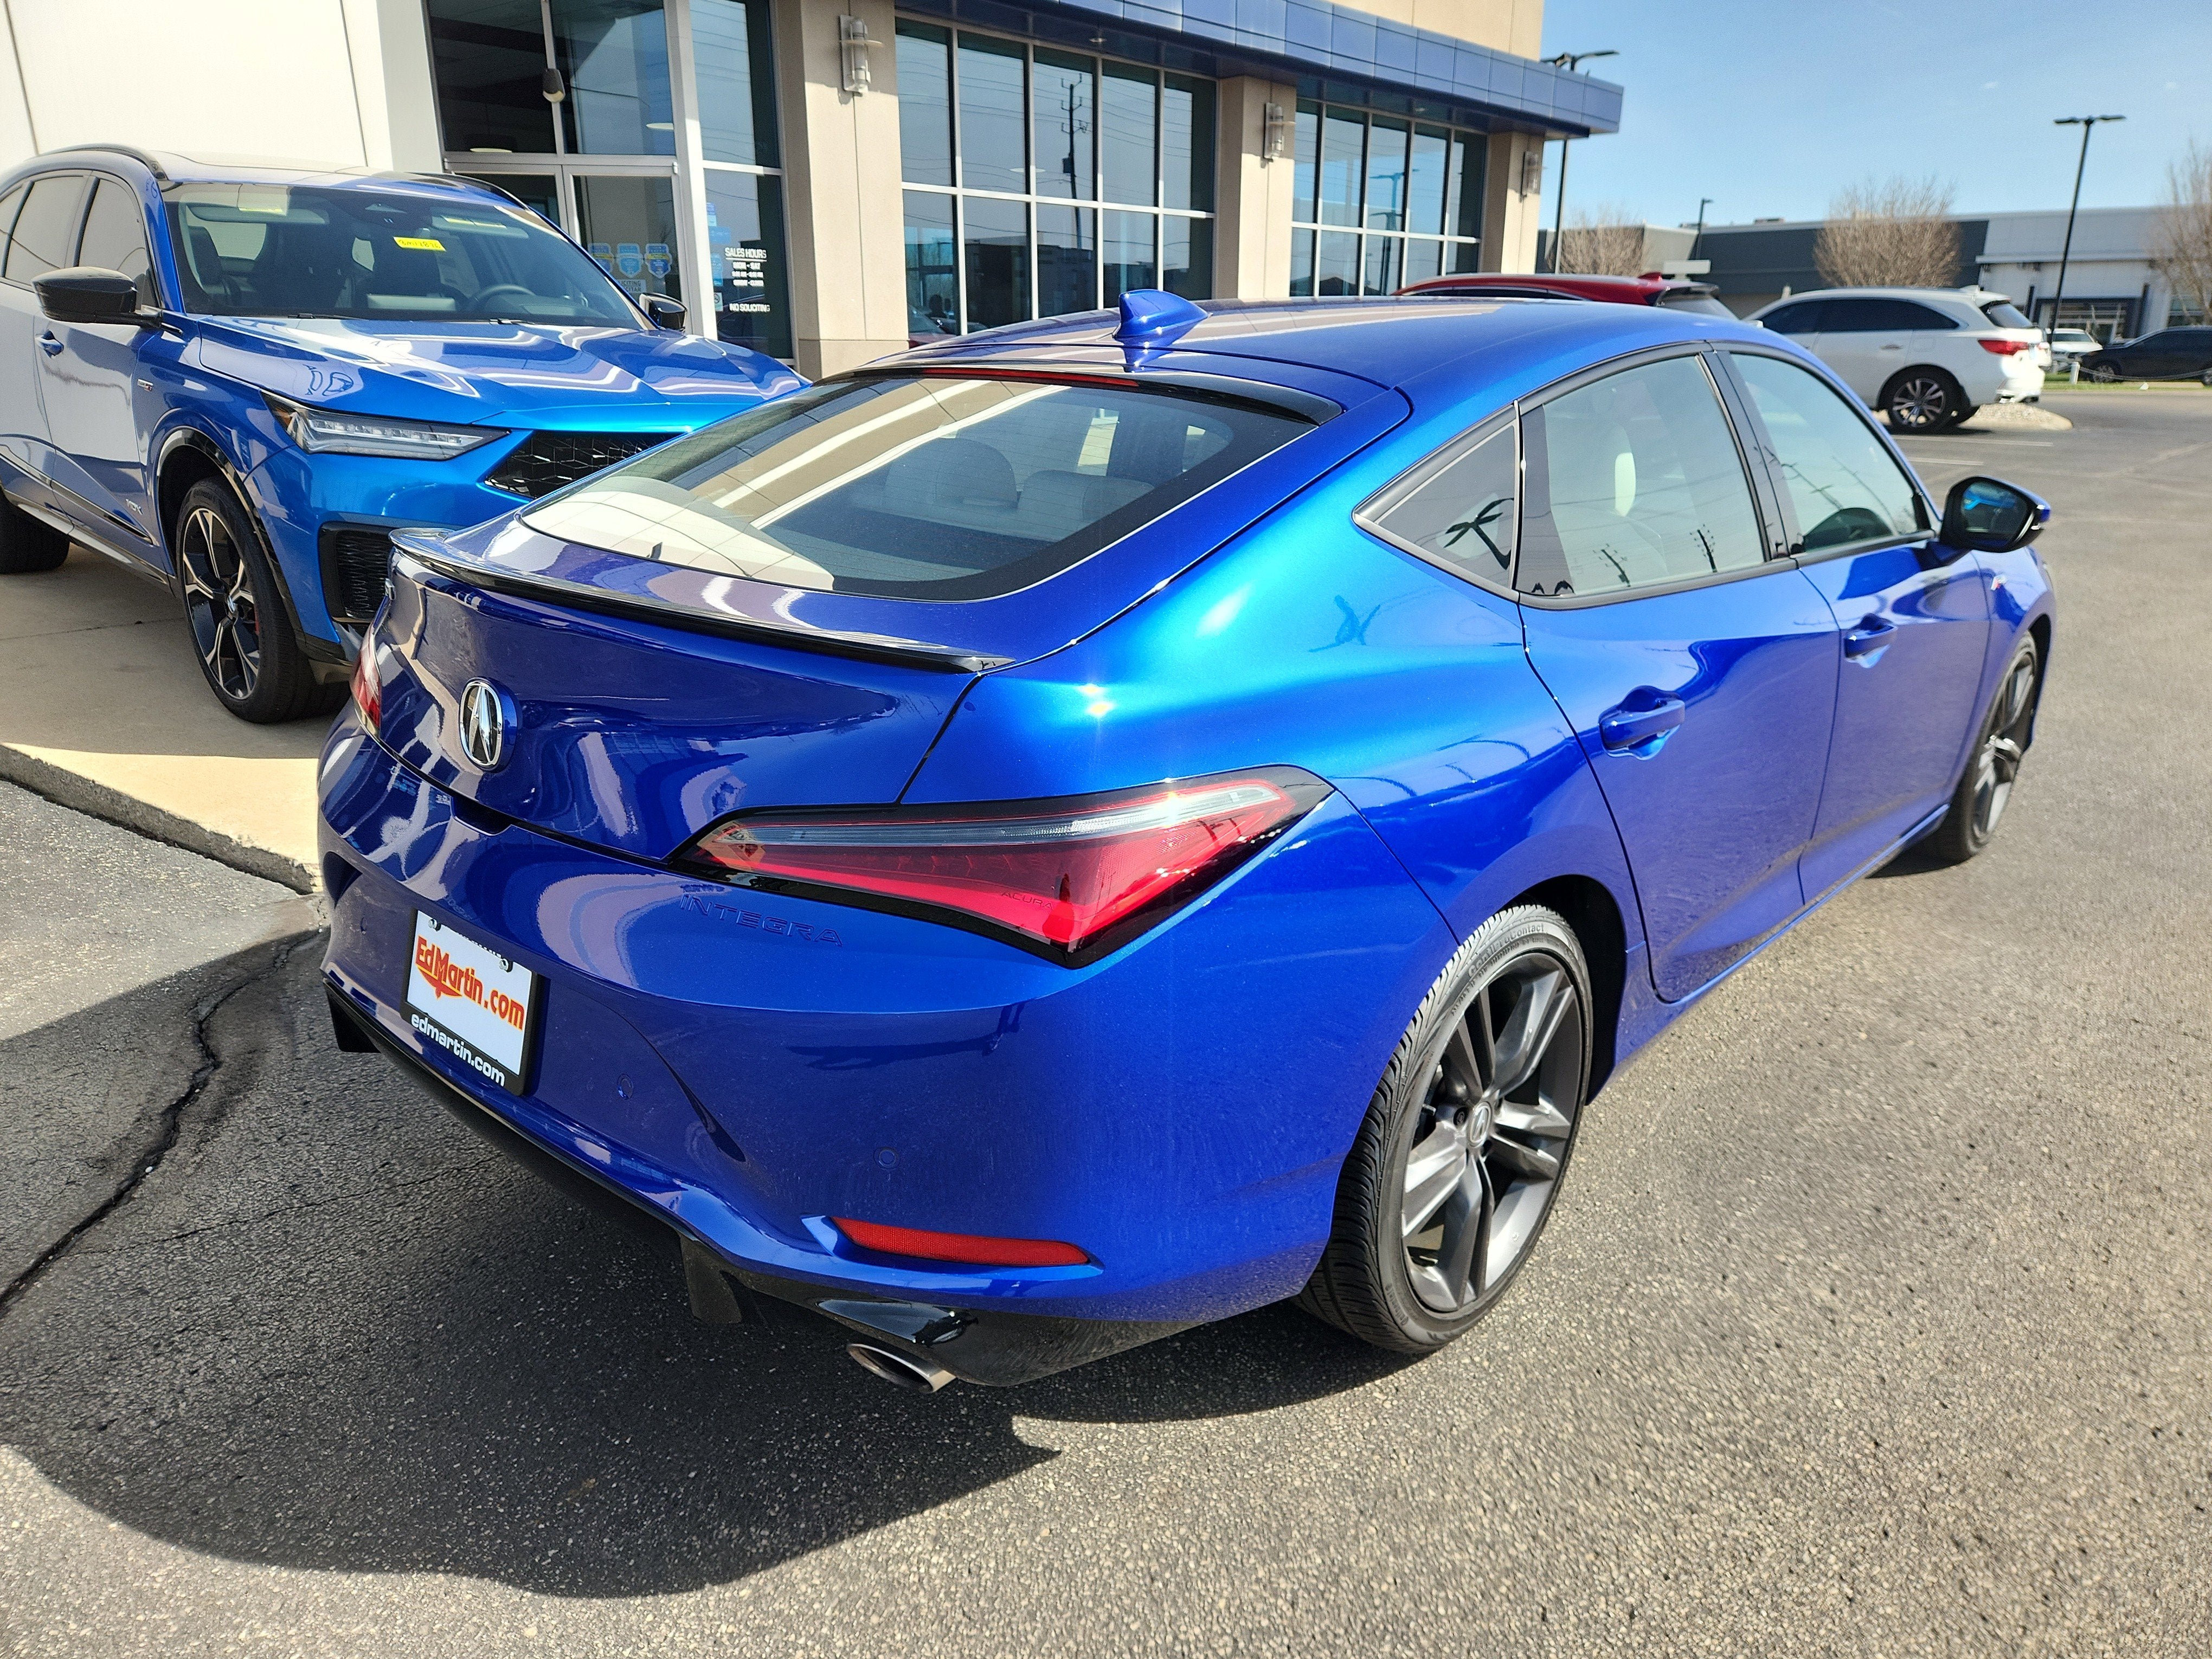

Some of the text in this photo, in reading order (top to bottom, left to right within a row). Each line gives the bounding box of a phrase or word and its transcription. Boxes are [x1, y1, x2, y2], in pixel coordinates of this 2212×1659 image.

[725, 247, 767, 259] SALES HOURS
[729, 303, 770, 312] NO SOLICITING
[1001, 892, 1052, 910] ACURA
[679, 893, 843, 947] INTEGRA
[415, 935, 525, 1031] EdMartin.com
[411, 1013, 506, 1088] edmartin.com
